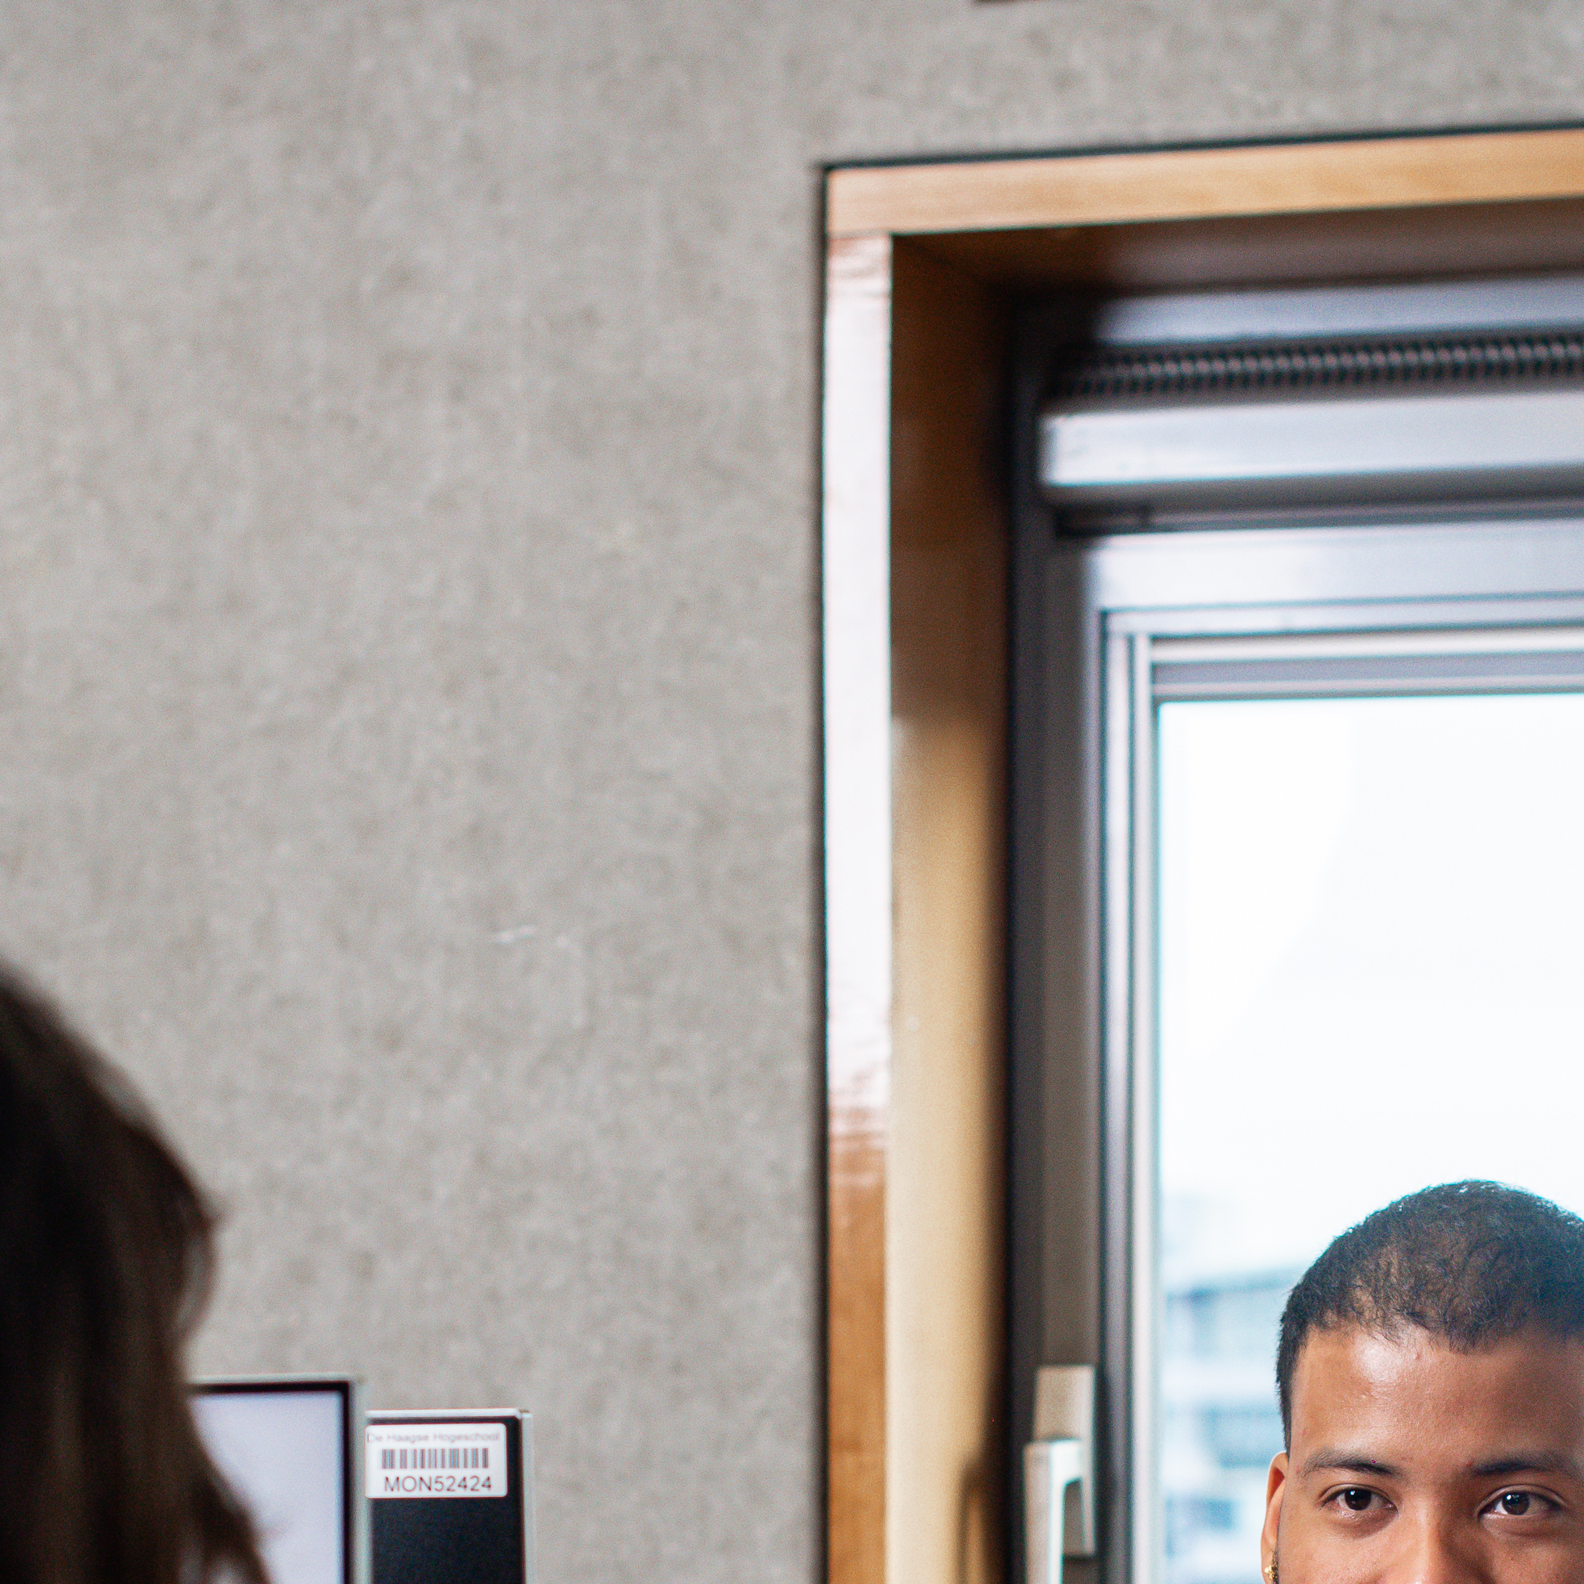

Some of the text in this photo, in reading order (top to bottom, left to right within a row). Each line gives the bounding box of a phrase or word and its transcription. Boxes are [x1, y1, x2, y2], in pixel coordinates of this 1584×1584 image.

[386, 1433, 429, 1444] Haagse
[433, 1432, 500, 1444] Hogeschool
[384, 1475, 492, 1493] MON52424
